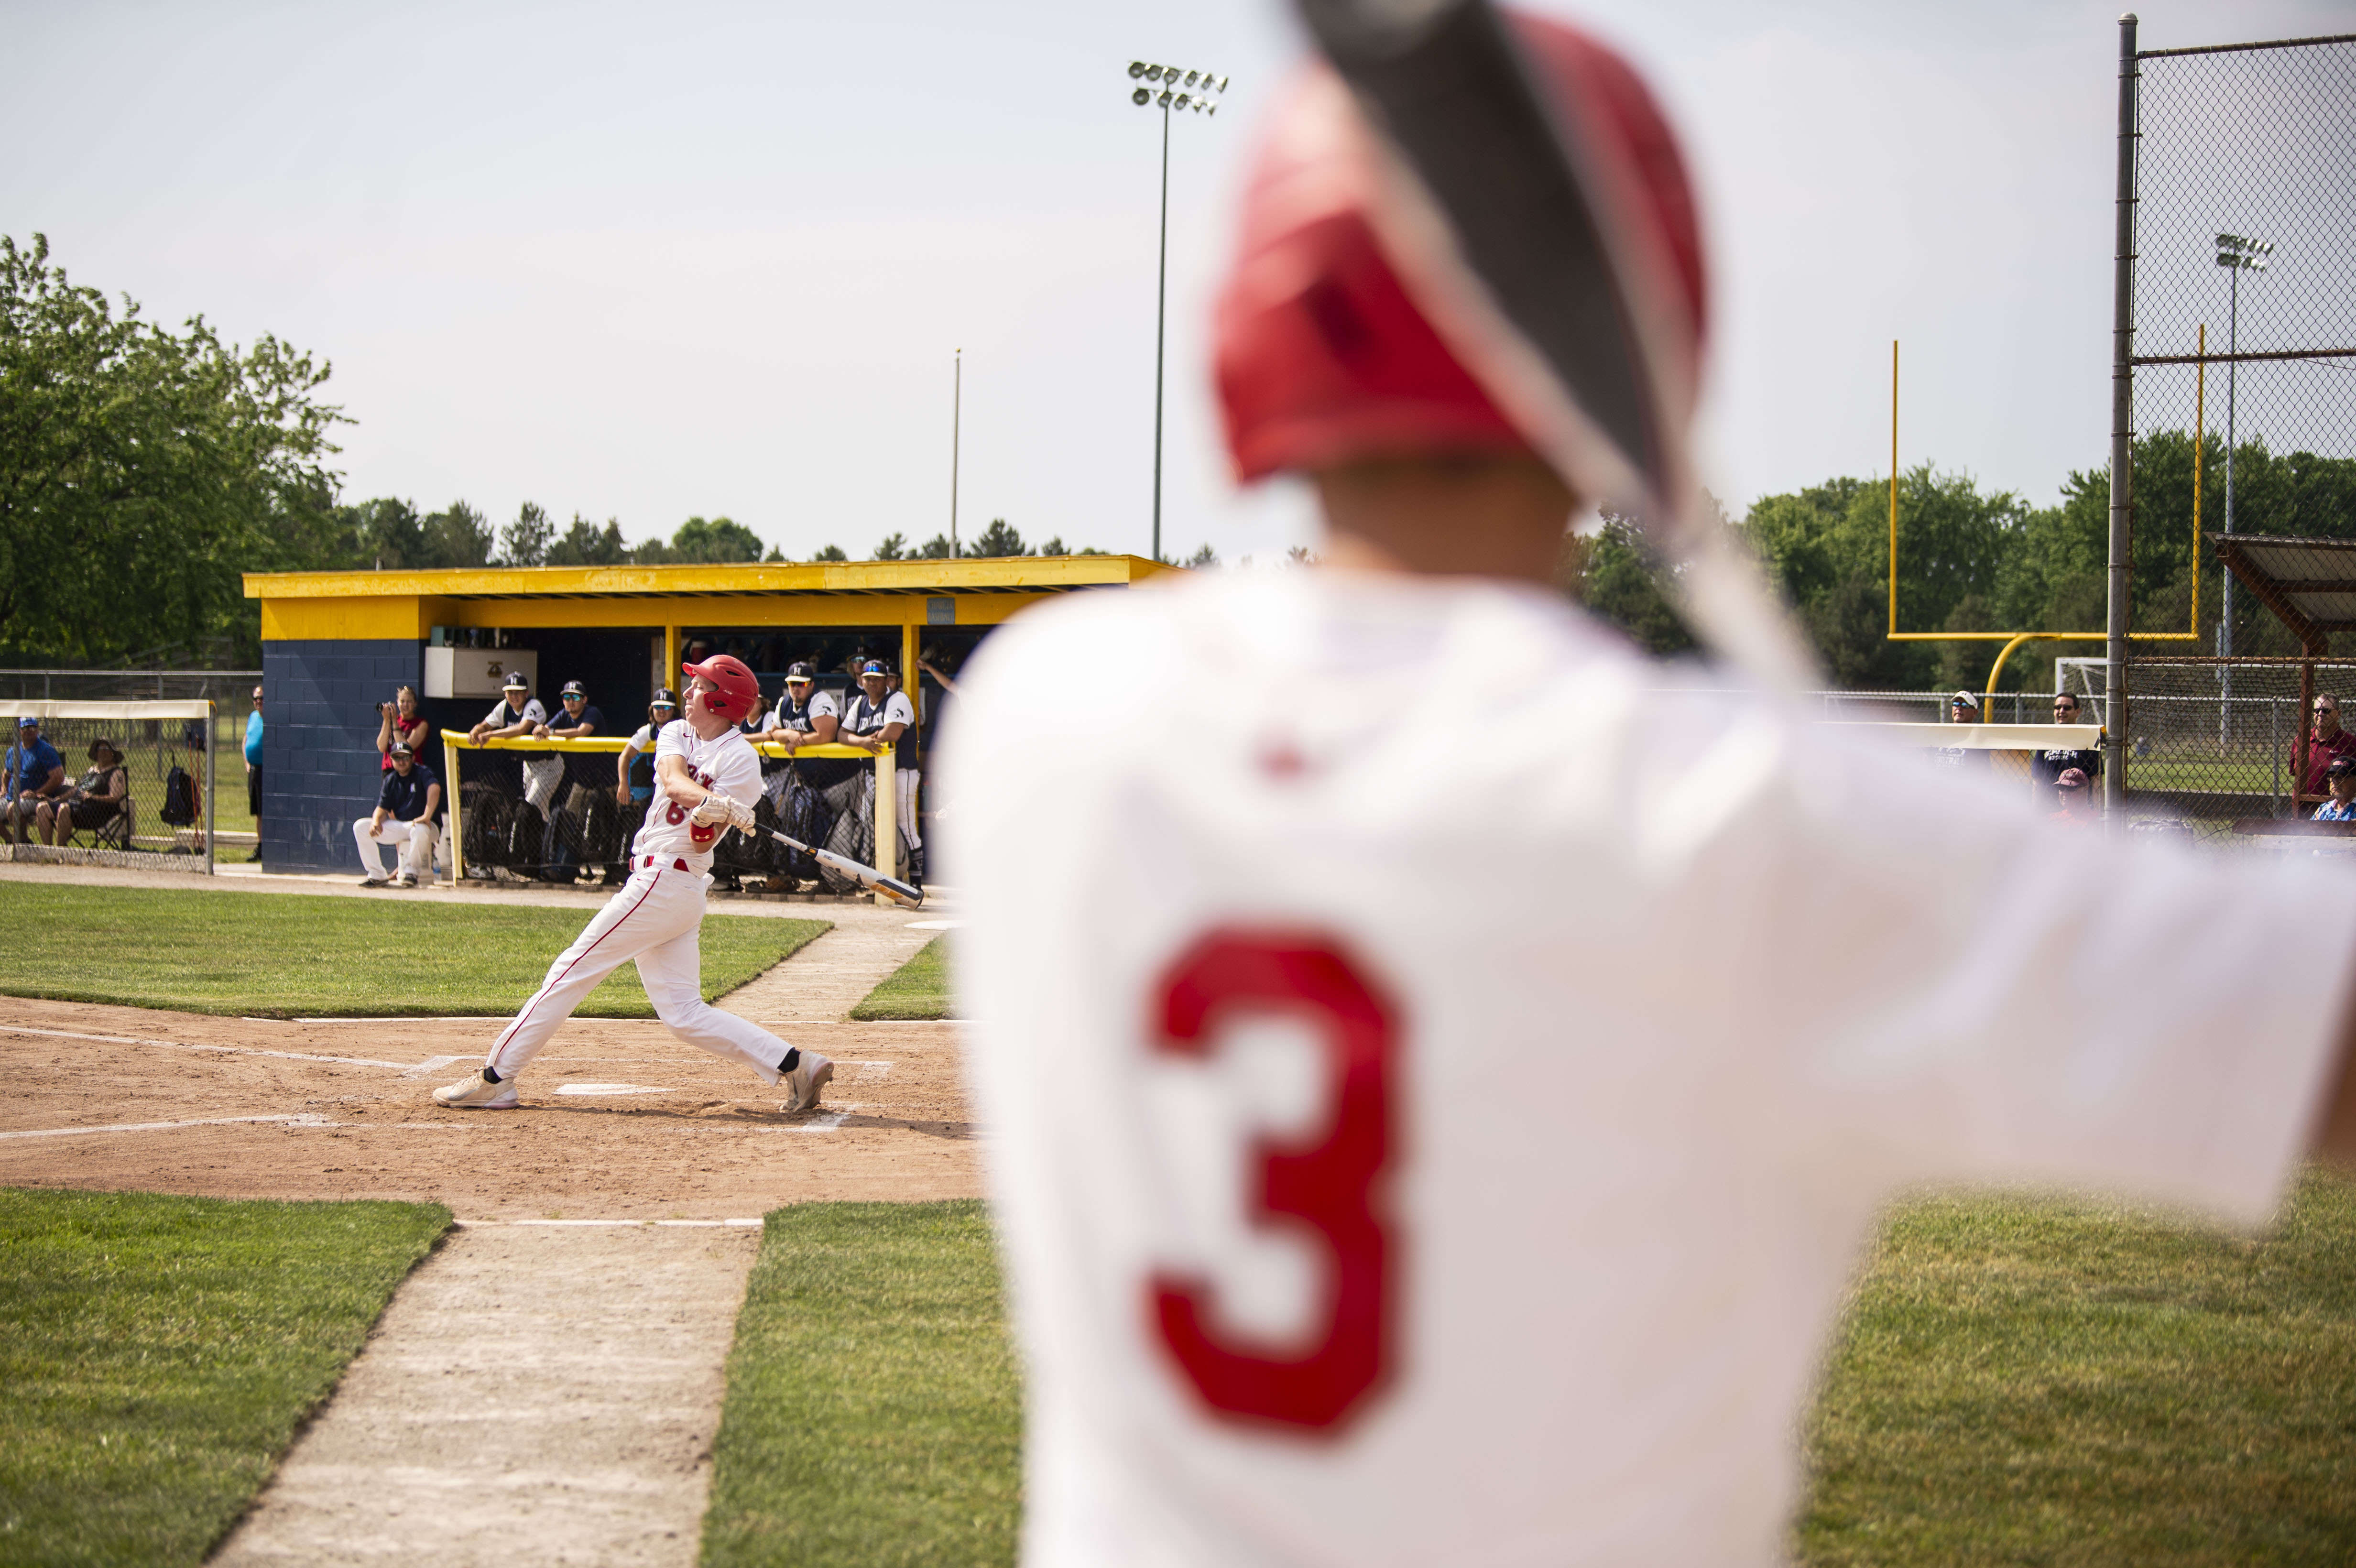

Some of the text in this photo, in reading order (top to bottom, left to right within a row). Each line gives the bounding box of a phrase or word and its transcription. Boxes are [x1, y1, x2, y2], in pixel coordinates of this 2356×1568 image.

[794, 666, 801, 675] H
[510, 676, 518, 685] H
[660, 691, 666, 700] H
[396, 742, 403, 750] H
[1148, 927, 1398, 1439] 3
